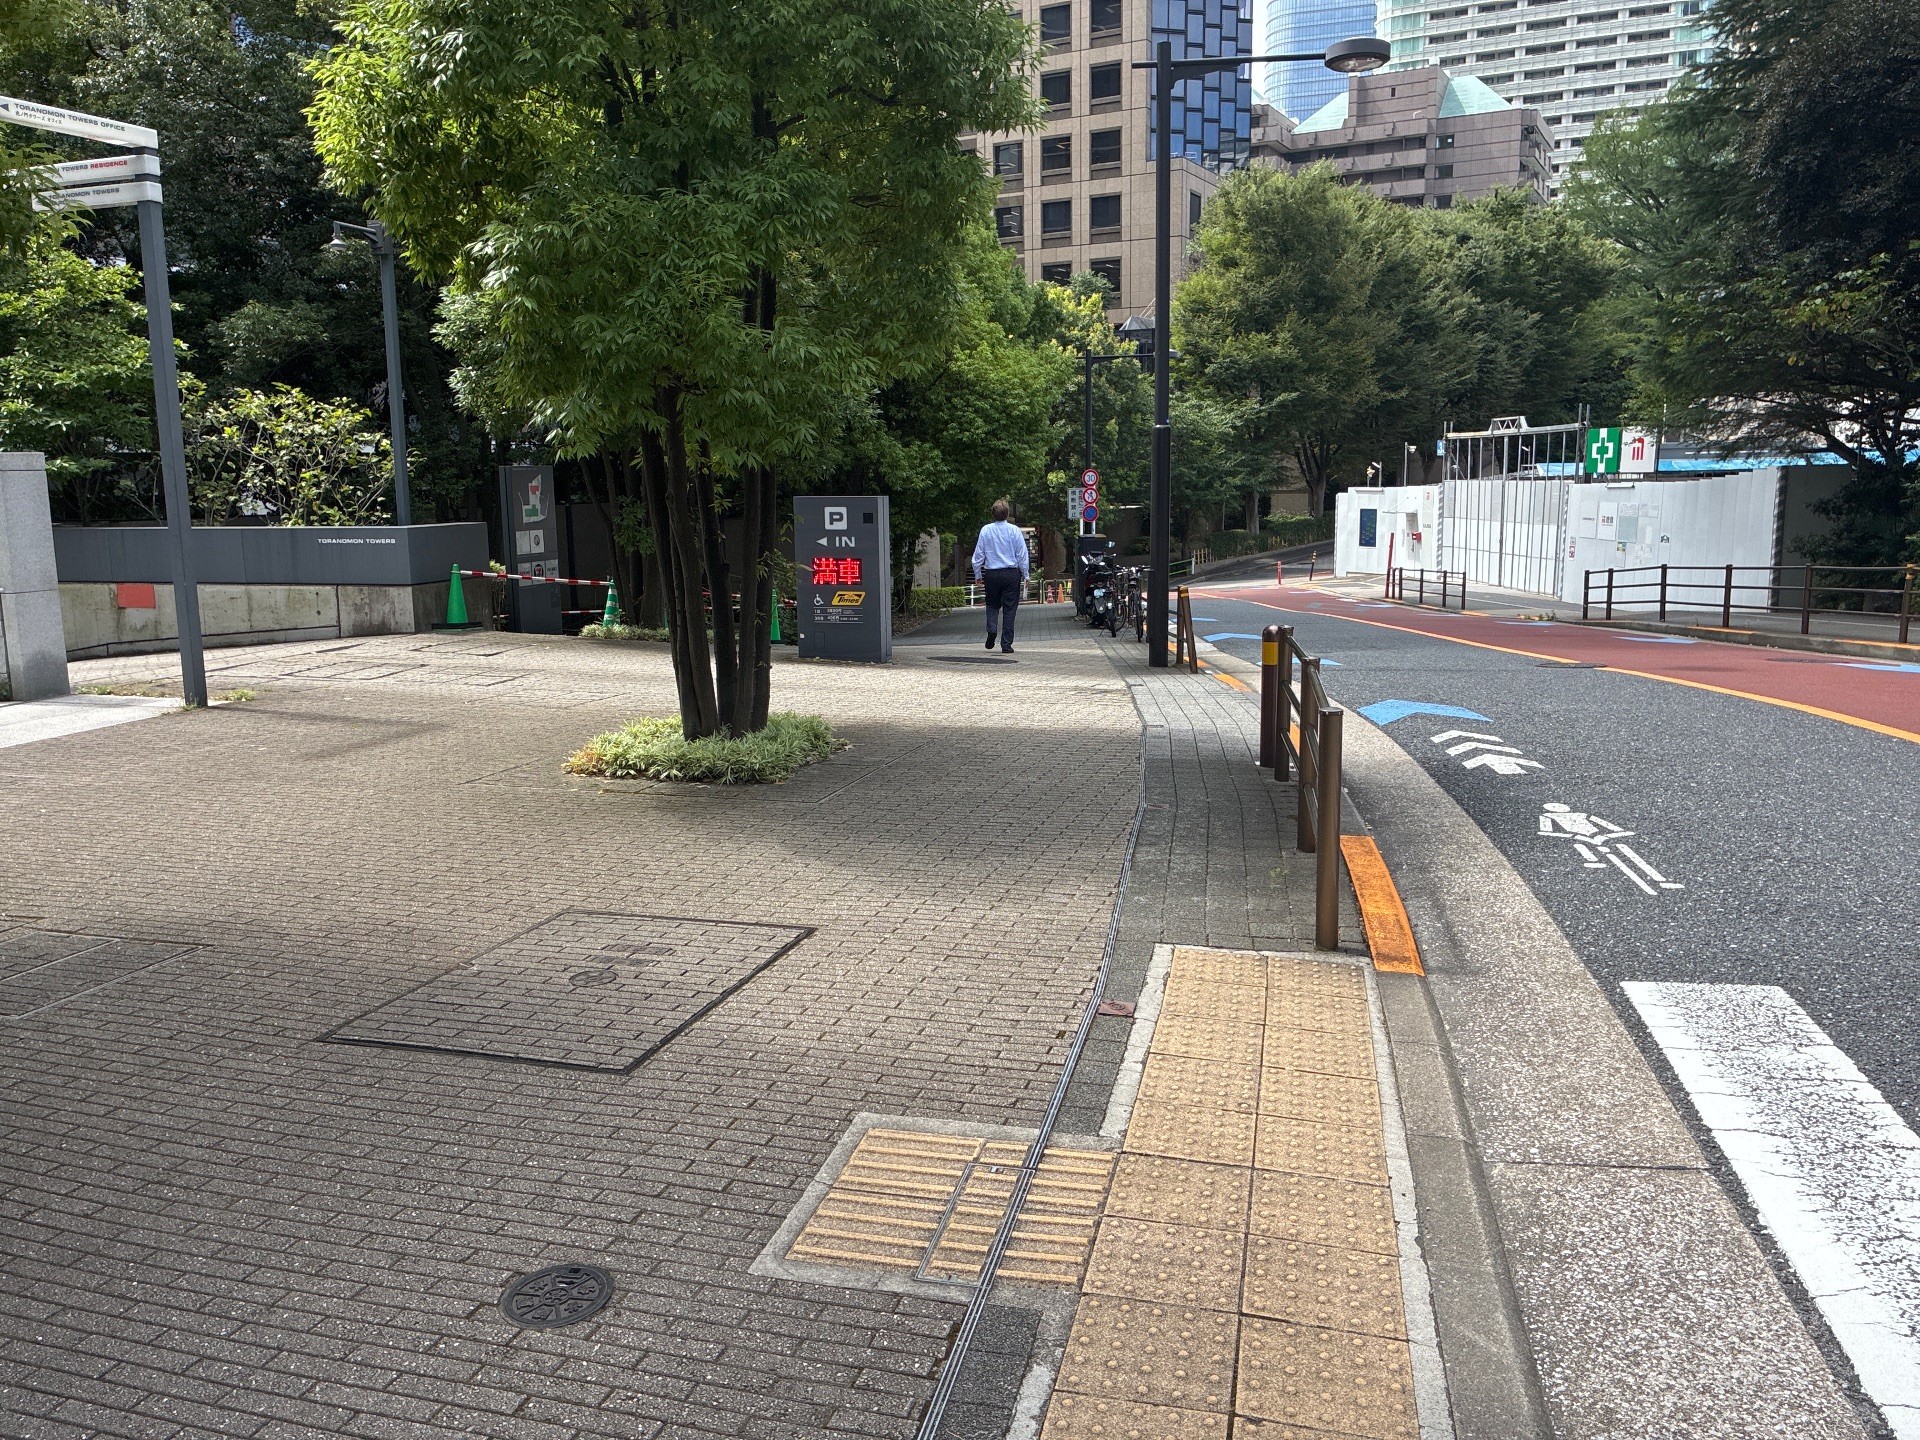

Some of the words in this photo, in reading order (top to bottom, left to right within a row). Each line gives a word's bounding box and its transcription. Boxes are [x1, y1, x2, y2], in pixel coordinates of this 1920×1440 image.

[14, 103, 65, 119] TORANOMON
[67, 115, 98, 126] TOWERS
[100, 121, 126, 132] OFFICE
[61, 164, 88, 172] TOWERS
[90, 159, 128, 170] RESIDENCE
[92, 187, 120, 195] TOWERS
[1086, 474, 1095, 482] 30
[828, 511, 844, 526] P
[835, 536, 856, 548] IN
[813, 557, 861, 585] 満車
[837, 596, 860, 604] Times
